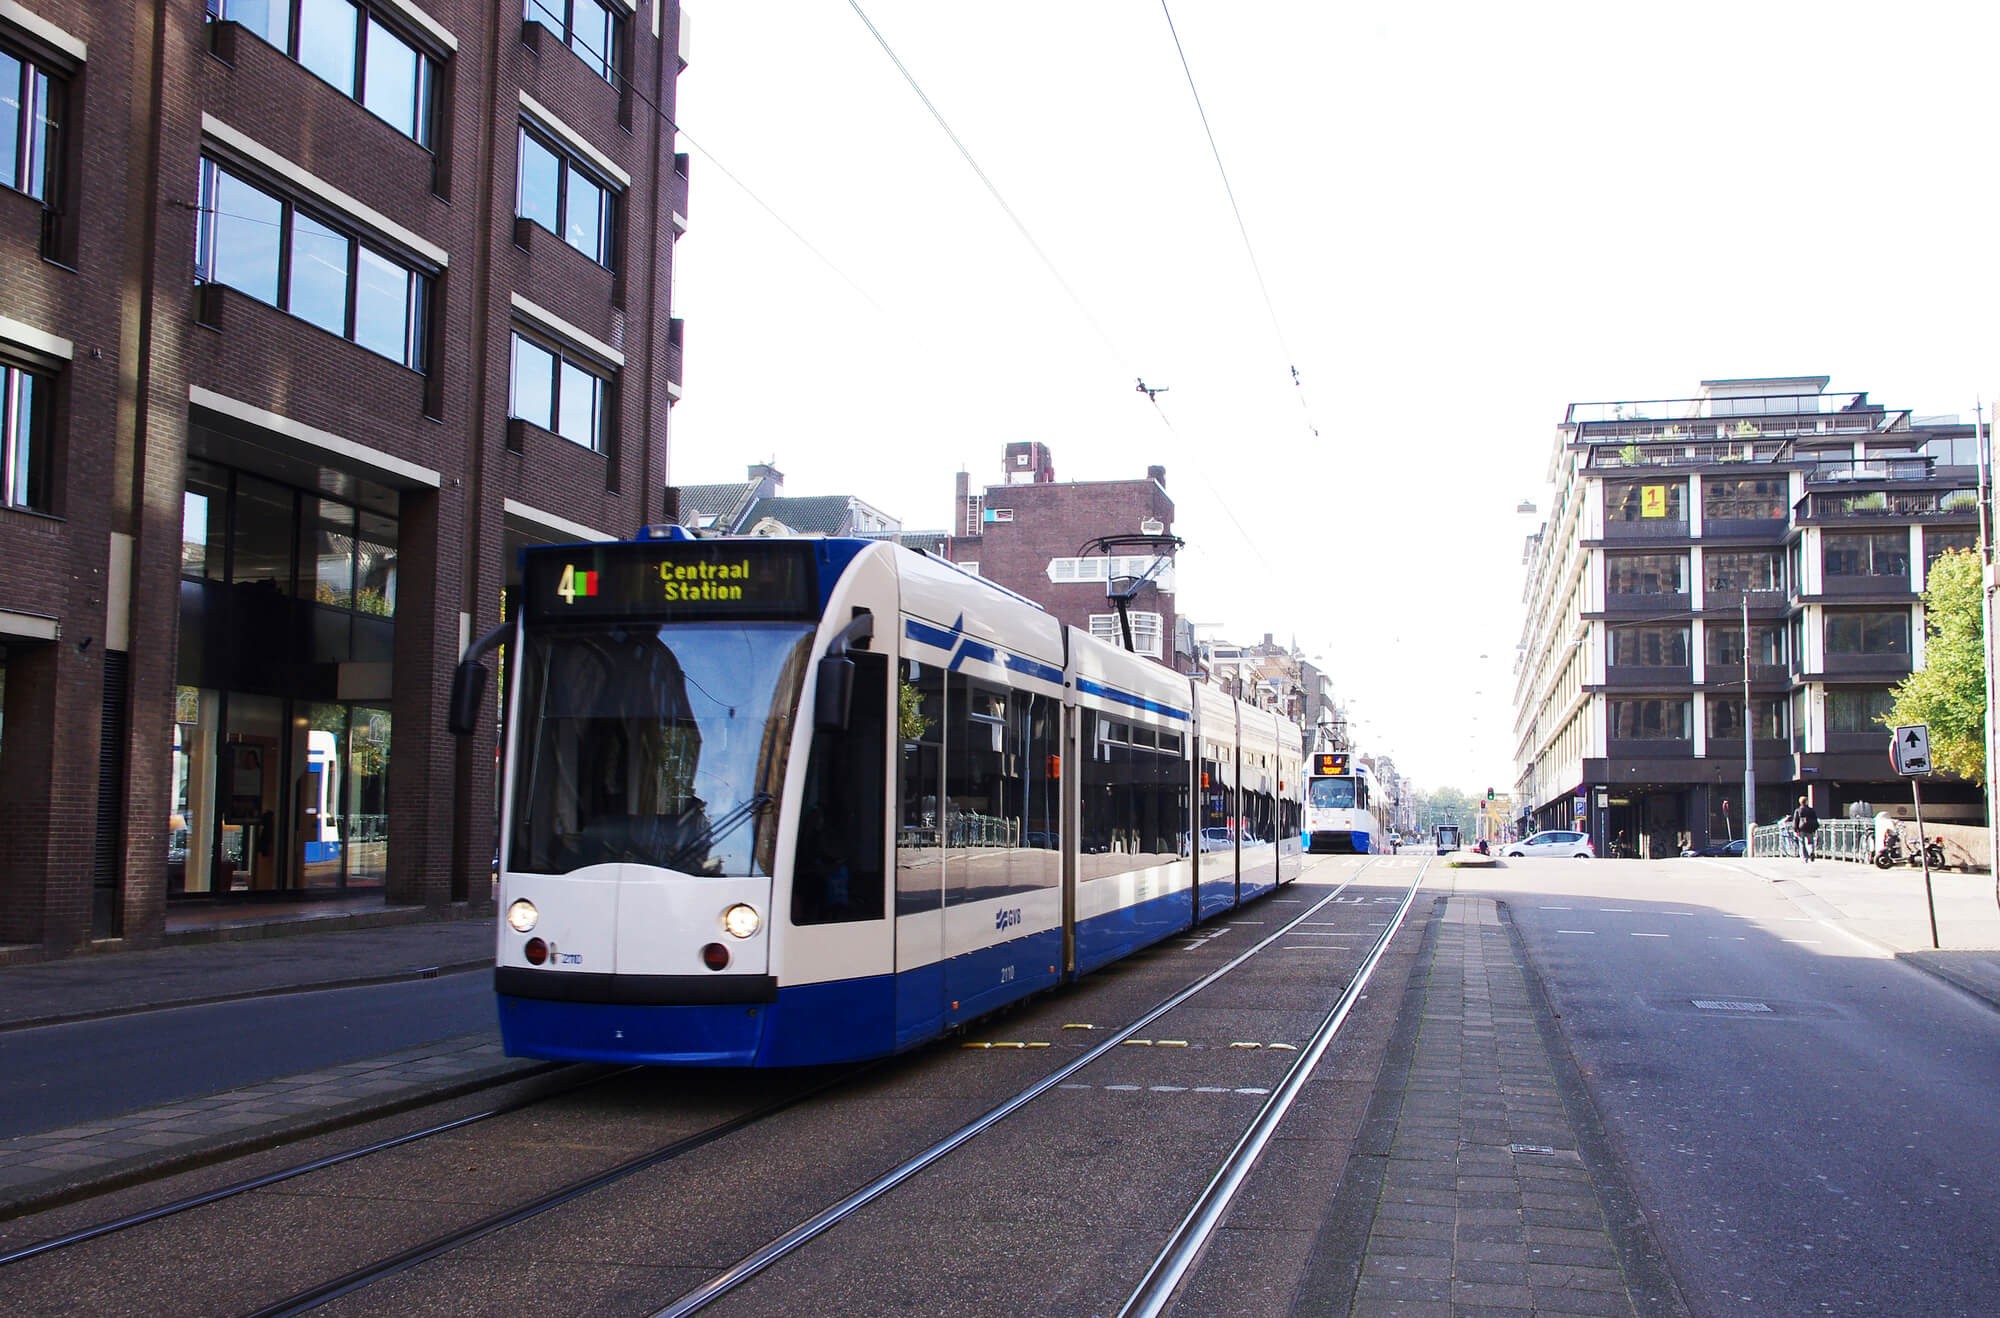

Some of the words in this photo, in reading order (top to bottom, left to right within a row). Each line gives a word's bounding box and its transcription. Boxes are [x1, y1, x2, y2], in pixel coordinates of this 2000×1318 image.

[659, 559, 750, 580] Centraal
[557, 563, 576, 605] 4
[664, 581, 743, 601] Station
